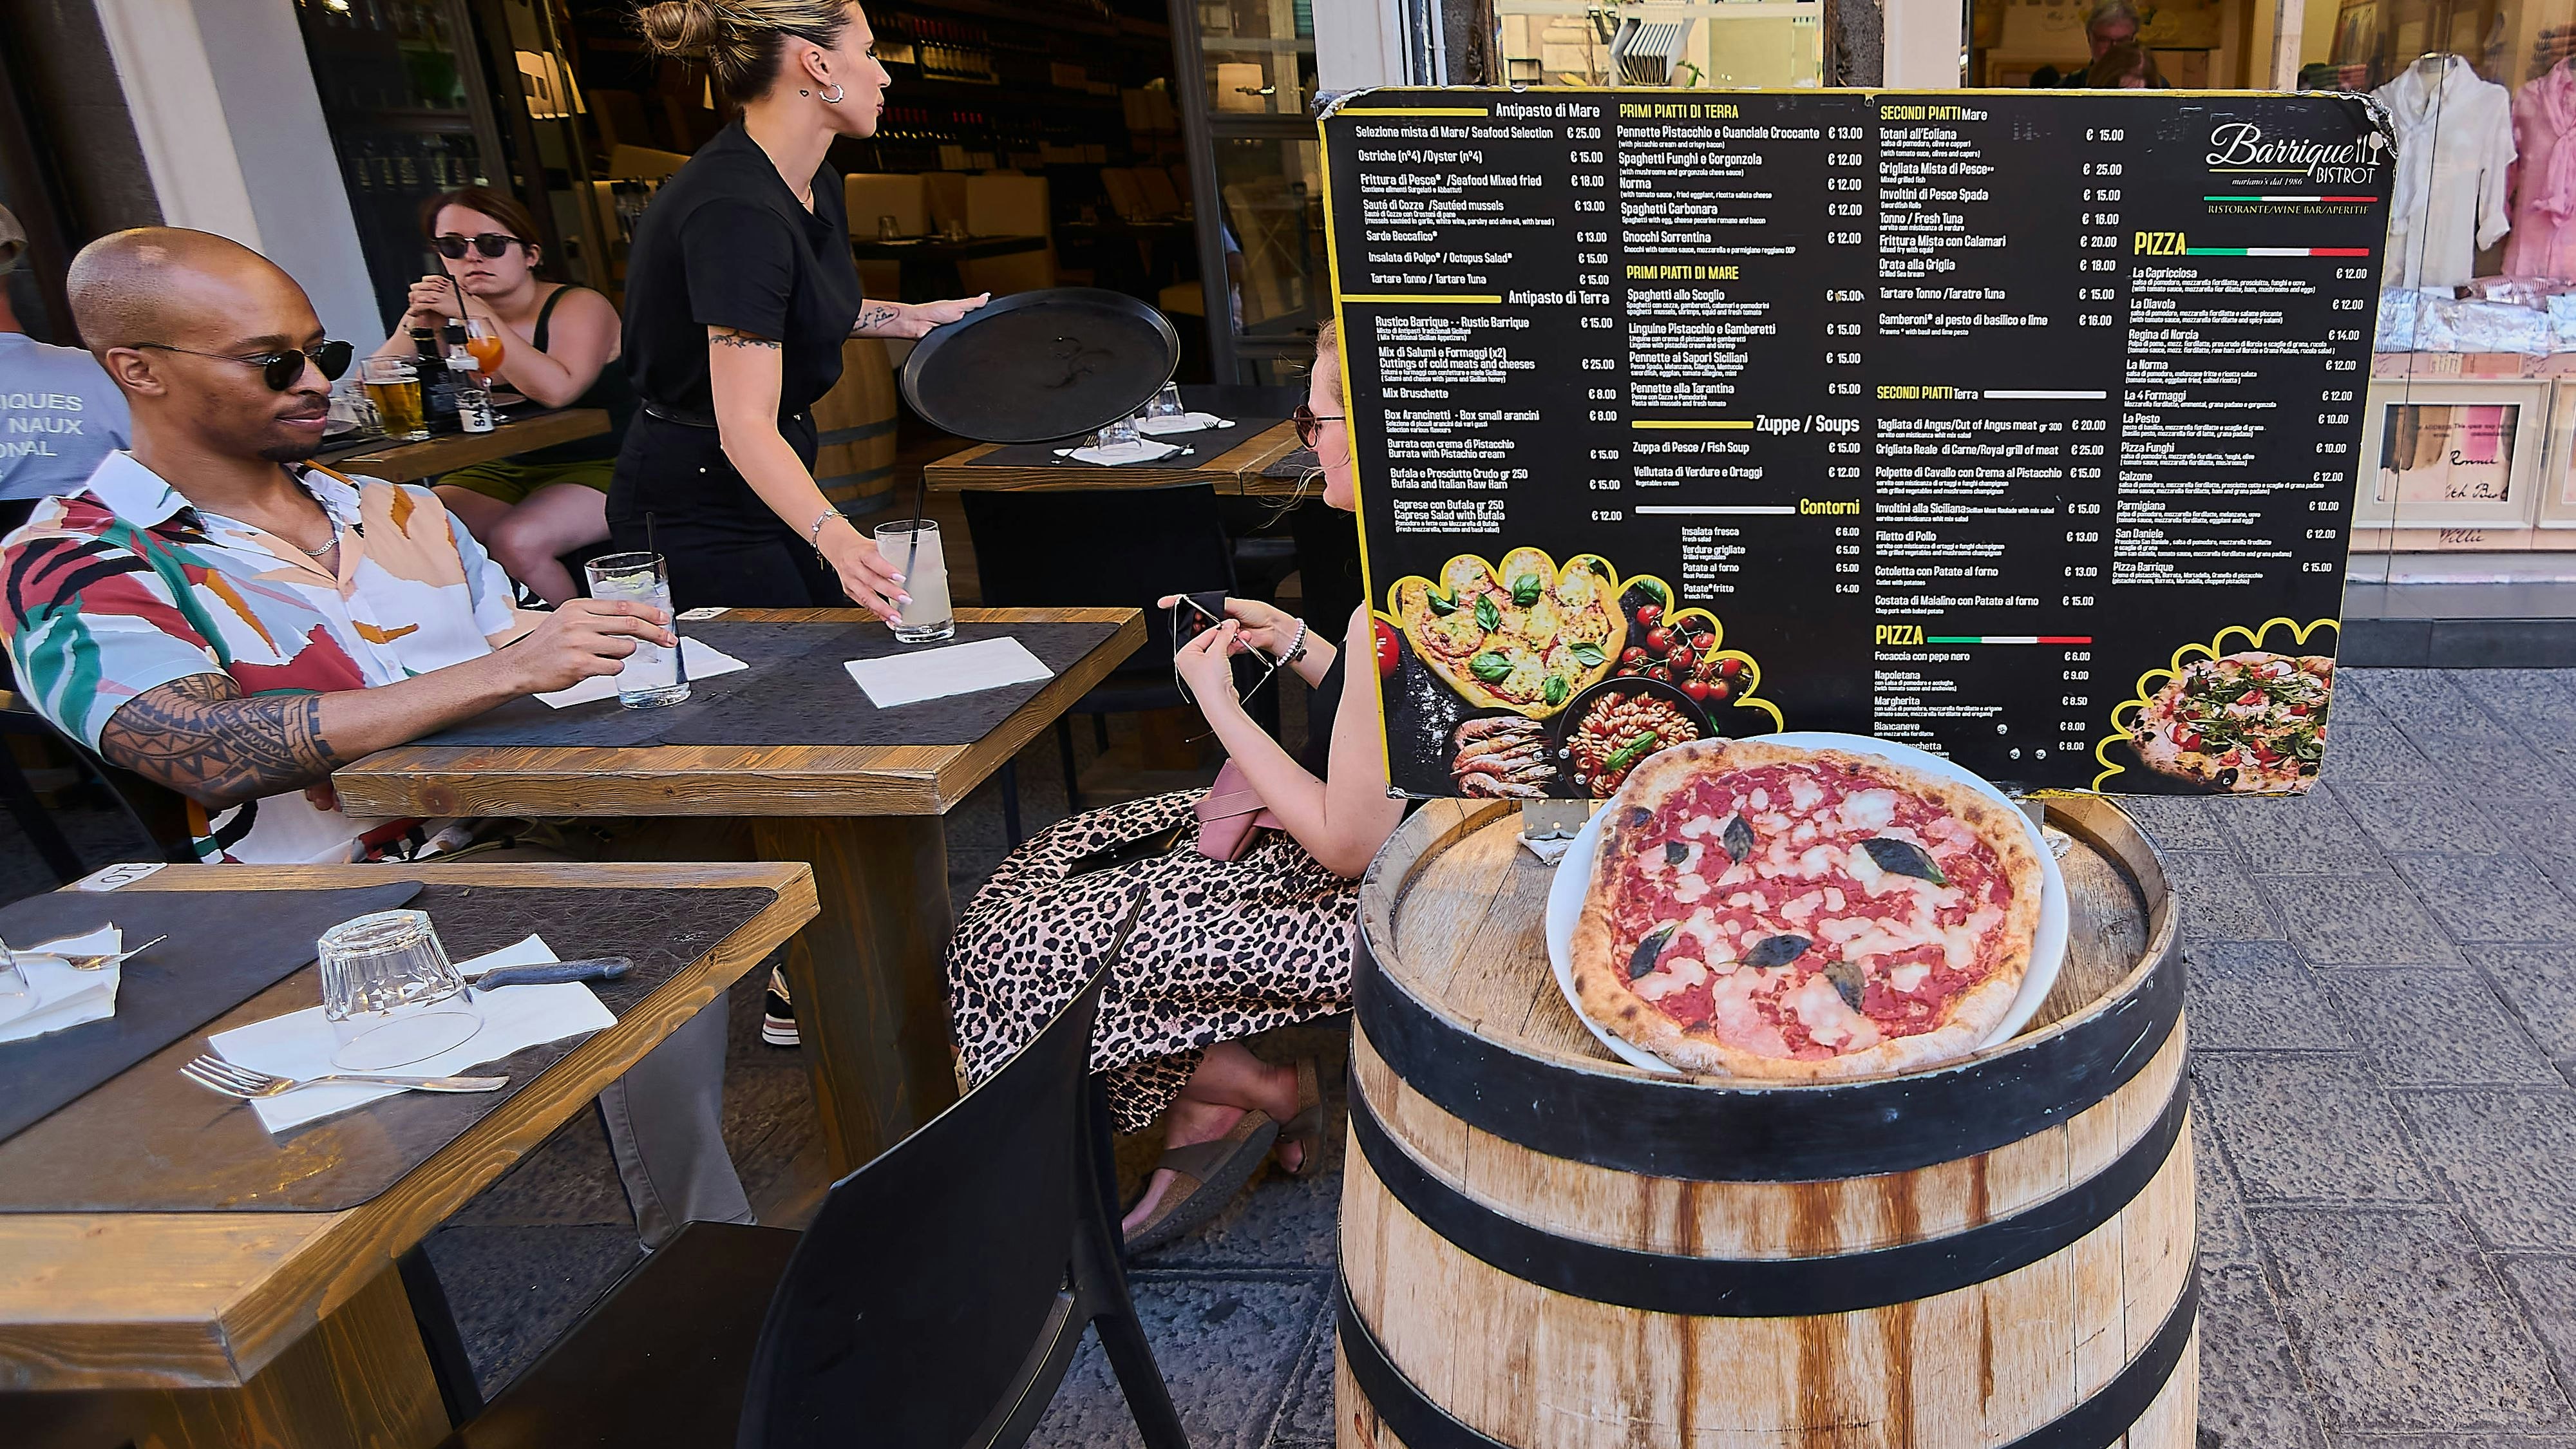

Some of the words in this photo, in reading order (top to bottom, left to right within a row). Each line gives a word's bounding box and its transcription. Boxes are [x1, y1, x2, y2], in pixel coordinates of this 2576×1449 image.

[1496, 102, 1553, 120] Antipasto
[1555, 102, 1566, 117] di
[1569, 103, 1600, 118] Mare
[1620, 103, 1652, 118] PRIMI
[1654, 104, 1687, 118] PIATTI
[1690, 104, 1701, 118] DI
[1703, 104, 1739, 118] TERRA
[1880, 105, 1926, 120] SECONDI
[1928, 106, 1961, 120] PIATTI
[1962, 108, 1988, 121] Mare
[1356, 126, 1399, 138] Selezione
[1401, 125, 1428, 138] mista
[1430, 125, 1439, 138] di
[1440, 126, 1470, 139] Mare/
[1471, 125, 1510, 138] Seafood
[1511, 126, 1553, 138] Selection
[1566, 126, 1574, 139] €
[1575, 127, 1601, 139] 25.00
[1616, 125, 1661, 138] Pennette
[1662, 125, 1712, 138] Pistacchio
[1714, 128, 1721, 138] e
[1722, 125, 1769, 139] Guanciale
[1770, 126, 1820, 140] Croccante
[1828, 126, 1835, 139] €
[1837, 127, 1863, 140] 13.00
[2206, 122, 2354, 176] Barrique
[1618, 151, 1665, 167] Spaghetti
[1666, 151, 1699, 167] Funghi
[1700, 154, 1707, 165] e
[1708, 151, 1762, 167] Gorgonzola
[1360, 173, 1397, 185] Frittura
[1398, 173, 1408, 185] di
[1490, 173, 1518, 186] Mixed
[1519, 174, 1542, 186] fried
[2269, 177, 2283, 185] dal
[2316, 166, 2376, 184] BISTROT
[1619, 176, 1652, 189] Norma
[1880, 187, 1917, 200] Involtini
[1918, 187, 1928, 200] di
[1929, 187, 1958, 200] Pesce
[1959, 188, 1989, 203] Spada
[2083, 189, 2091, 201] €
[2096, 189, 2121, 201] 15.00
[1363, 199, 1388, 210] Sauté
[1388, 199, 1398, 210] di
[1398, 199, 1425, 211] Cozze
[1468, 200, 1504, 211] mussels
[1575, 200, 1582, 211] €
[1582, 200, 1605, 212] 13.00
[1620, 202, 1667, 216] Spaghetti
[1668, 202, 1718, 215] Carbonara
[2208, 205, 2300, 214] RISTORANTE/WINE
[1622, 230, 1660, 243] Gnocchi
[1661, 231, 1712, 243] Sorrentina
[1879, 234, 1917, 247] Frittura
[1917, 234, 1944, 247] Mista
[1946, 237, 1963, 247] con
[1964, 234, 2006, 247] Calamari
[2134, 231, 2186, 256] PIZZA
[1626, 265, 1658, 279] PRIMI
[1660, 265, 1692, 279] PIATTI
[1694, 265, 1705, 279] DI
[1708, 265, 1739, 280] MARE
[2132, 267, 2145, 278] La
[2145, 267, 2198, 279] Capricciosa
[2336, 268, 2344, 279] €
[2345, 268, 2367, 279] 12.00
[1508, 290, 1564, 307] Antipasto
[1566, 290, 1577, 305] di
[1578, 290, 1610, 305] Terra
[1627, 288, 1672, 303] Spaghetti
[1673, 289, 1691, 301] allo
[1692, 289, 1725, 303] Scoglio
[2130, 298, 2142, 309] La
[2143, 298, 2176, 309] Diavola
[1629, 323, 1667, 336] Linguine
[1668, 323, 1716, 335] Pistacchio
[1716, 325, 1723, 334] e
[1724, 323, 1776, 335] Gamberetti
[1379, 357, 1417, 370] Cuttings
[1418, 357, 1428, 369] of
[1429, 357, 1449, 369] cold
[1450, 357, 1479, 369] meats
[1480, 357, 1497, 369] and
[1498, 358, 1535, 370] cheeses
[2126, 359, 2138, 370] La
[2139, 359, 2168, 370] Norma
[1382, 387, 1399, 398] Mix
[1399, 387, 1449, 399] Bruschette
[1588, 388, 1596, 400] €
[1596, 388, 1616, 400] 8.00
[1630, 382, 1672, 395] Pennette
[1673, 382, 1690, 393] alla
[1691, 382, 1735, 394] Tarantina
[1877, 386, 1920, 399] SECONDI
[1922, 385, 1953, 400] PIATTI
[1953, 387, 1978, 400] Terra
[2124, 390, 2136, 402] La
[2136, 390, 2144, 401] 4
[2145, 390, 2187, 402] Formaggi
[1756, 414, 1801, 436] Zuppe
[1815, 414, 1860, 436] Soups
[2123, 413, 2134, 424] La
[2135, 413, 2161, 424] Pesto
[8, 417, 84, 435] NAUX
[1388, 448, 1420, 459] Burrata
[1421, 448, 1440, 459] with
[1441, 448, 1478, 459] Pistachio
[1479, 451, 1506, 459] cream
[2121, 441, 2145, 453] Pizza
[2145, 442, 2175, 454] Funghi
[2119, 470, 2153, 481] Calzone
[1800, 498, 1860, 515] Contorni
[2117, 500, 2166, 513] Parmigiana
[1681, 526, 1713, 538] Insalata
[1714, 526, 1739, 536] fresca
[1875, 530, 1904, 542] Filetto
[1905, 531, 1915, 542] di
[1915, 531, 1937, 542] Pollo
[2115, 528, 2132, 538] San
[2132, 528, 2164, 538] Daniele
[2112, 561, 2136, 572] Pizza
[2137, 562, 2174, 573] Barrique
[1875, 625, 1924, 645] PIZZA
[1875, 650, 1911, 661] Focaccia
[1929, 653, 1949, 663] pepe
[1950, 653, 1970, 661] nero
[2064, 651, 2071, 661] €
[2072, 651, 2090, 661] 6.00
[1874, 696, 1920, 706] Margherita
[2062, 696, 2069, 706] €
[2069, 696, 2088, 706] 8.50
[1874, 721, 1920, 731] Biancaneve
